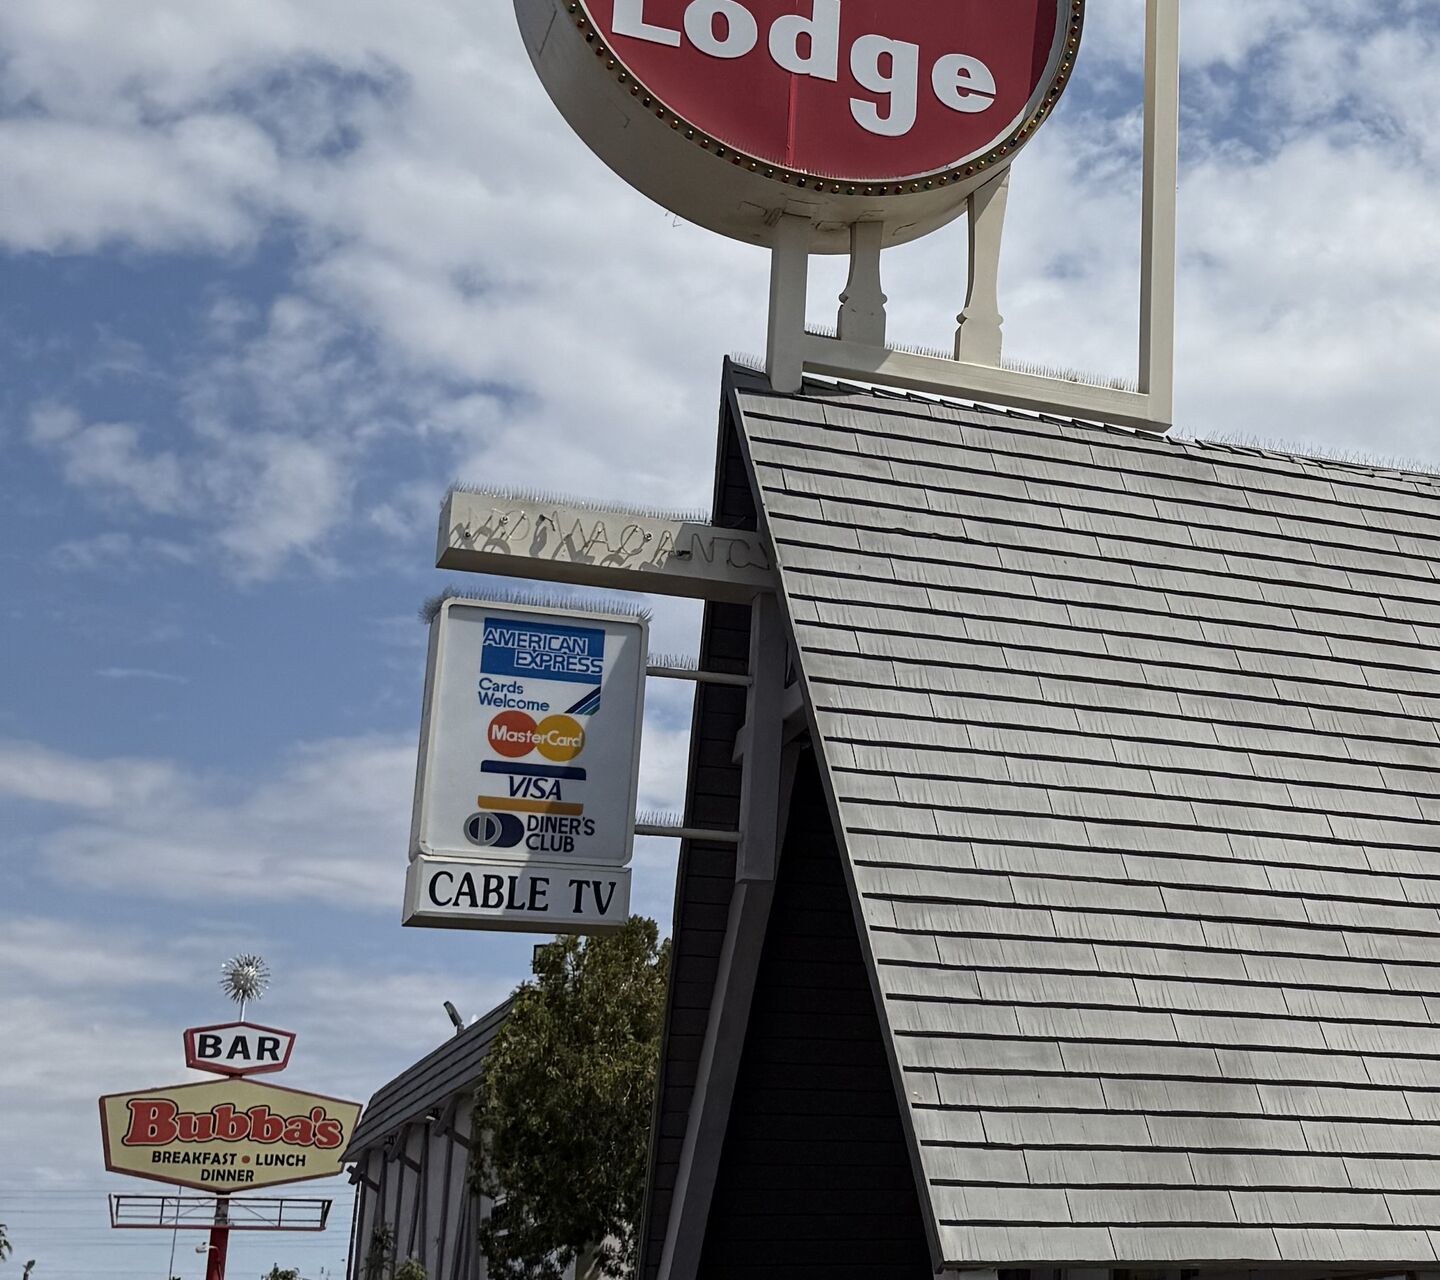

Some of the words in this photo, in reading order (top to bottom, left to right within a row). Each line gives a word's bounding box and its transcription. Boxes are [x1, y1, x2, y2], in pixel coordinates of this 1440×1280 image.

[483, 627, 589, 656] AMERICAN
[514, 649, 604, 676] EXPRESS
[479, 677, 524, 695] Cards
[478, 691, 550, 712] Welcome
[491, 724, 583, 748] MasterCard
[508, 775, 562, 801] VISA
[526, 814, 596, 836] DINER'S
[525, 833, 575, 853] CLUB
[428, 870, 549, 912] CABLE
[568, 878, 616, 915] TV
[197, 1033, 281, 1061] BAR
[122, 1098, 343, 1149] Bubba's
[151, 1151, 237, 1166] BREAKFAST
[255, 1153, 306, 1167] LUNCH
[200, 1169, 255, 1182] DINNER
